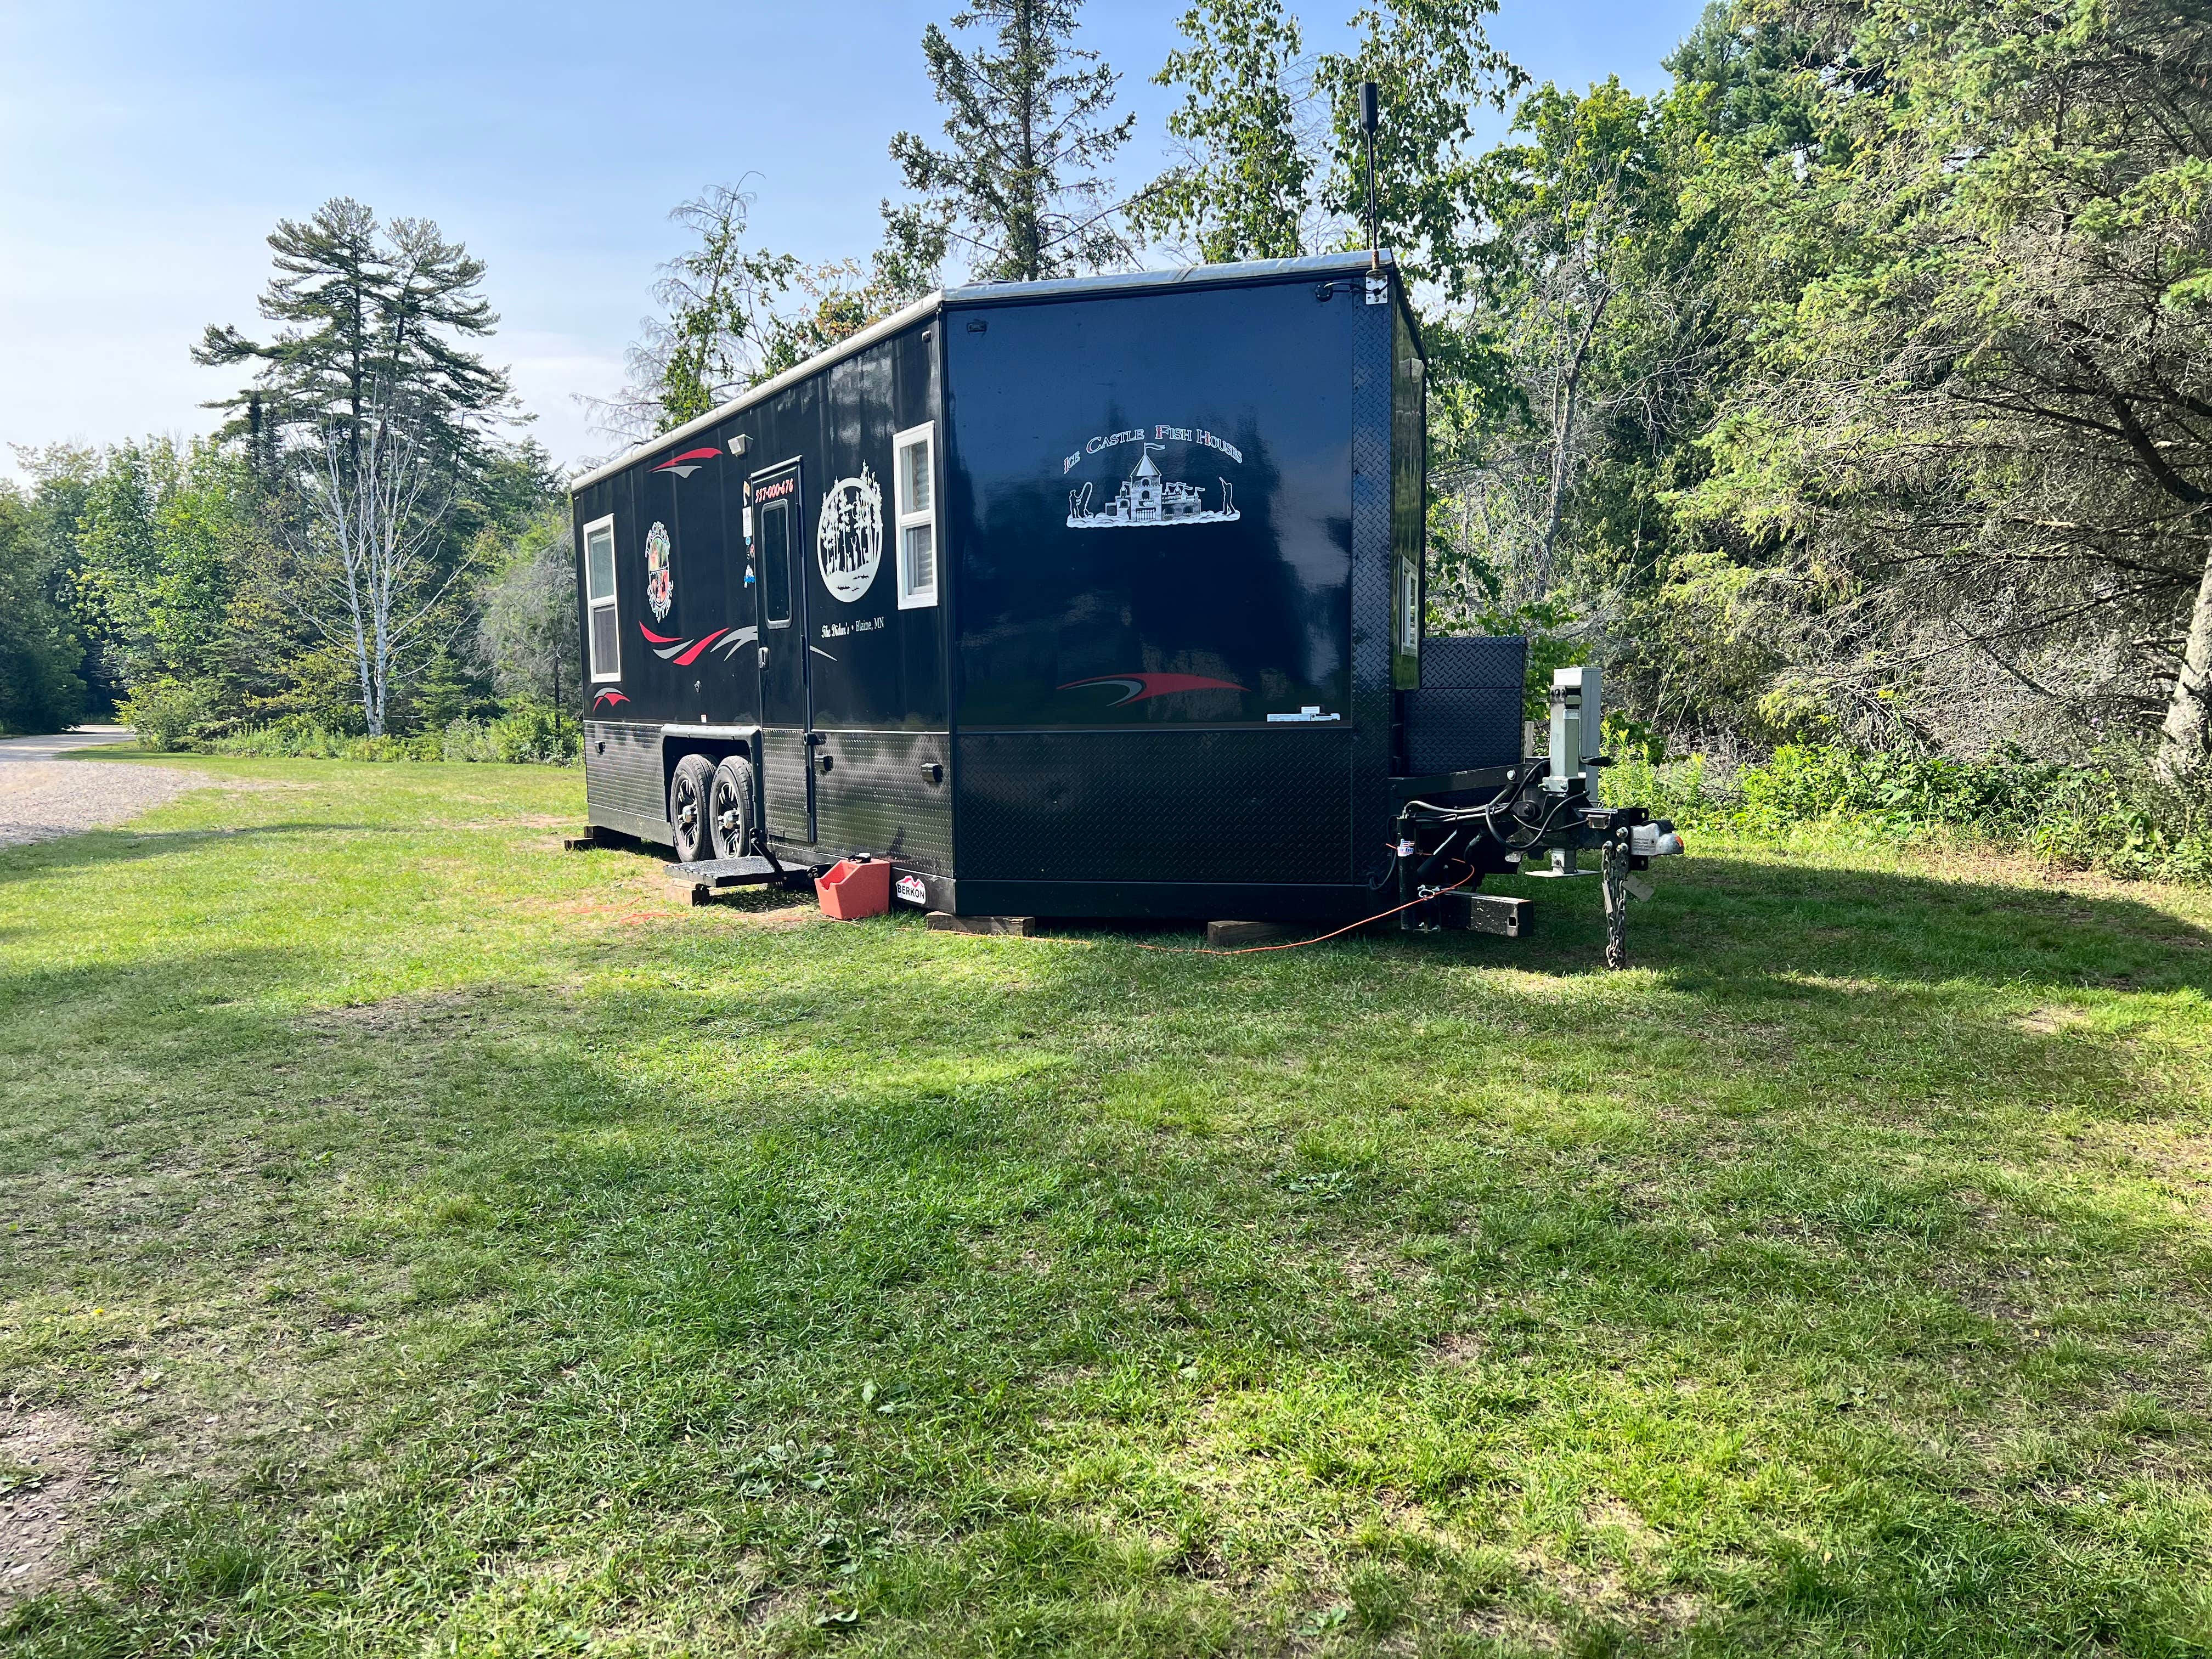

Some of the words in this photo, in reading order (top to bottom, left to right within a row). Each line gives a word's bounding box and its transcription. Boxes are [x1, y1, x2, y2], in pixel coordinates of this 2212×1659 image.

[1064, 450, 1080, 475] ICE
[1086, 428, 1146, 454] CASTLE
[1155, 425, 1193, 442] FISH
[1196, 428, 1243, 464] HOUSES
[821, 624, 831, 638] The
[855, 619, 873, 632] Blaine,
[874, 616, 884, 629] MN
[897, 884, 924, 899] BERKON
